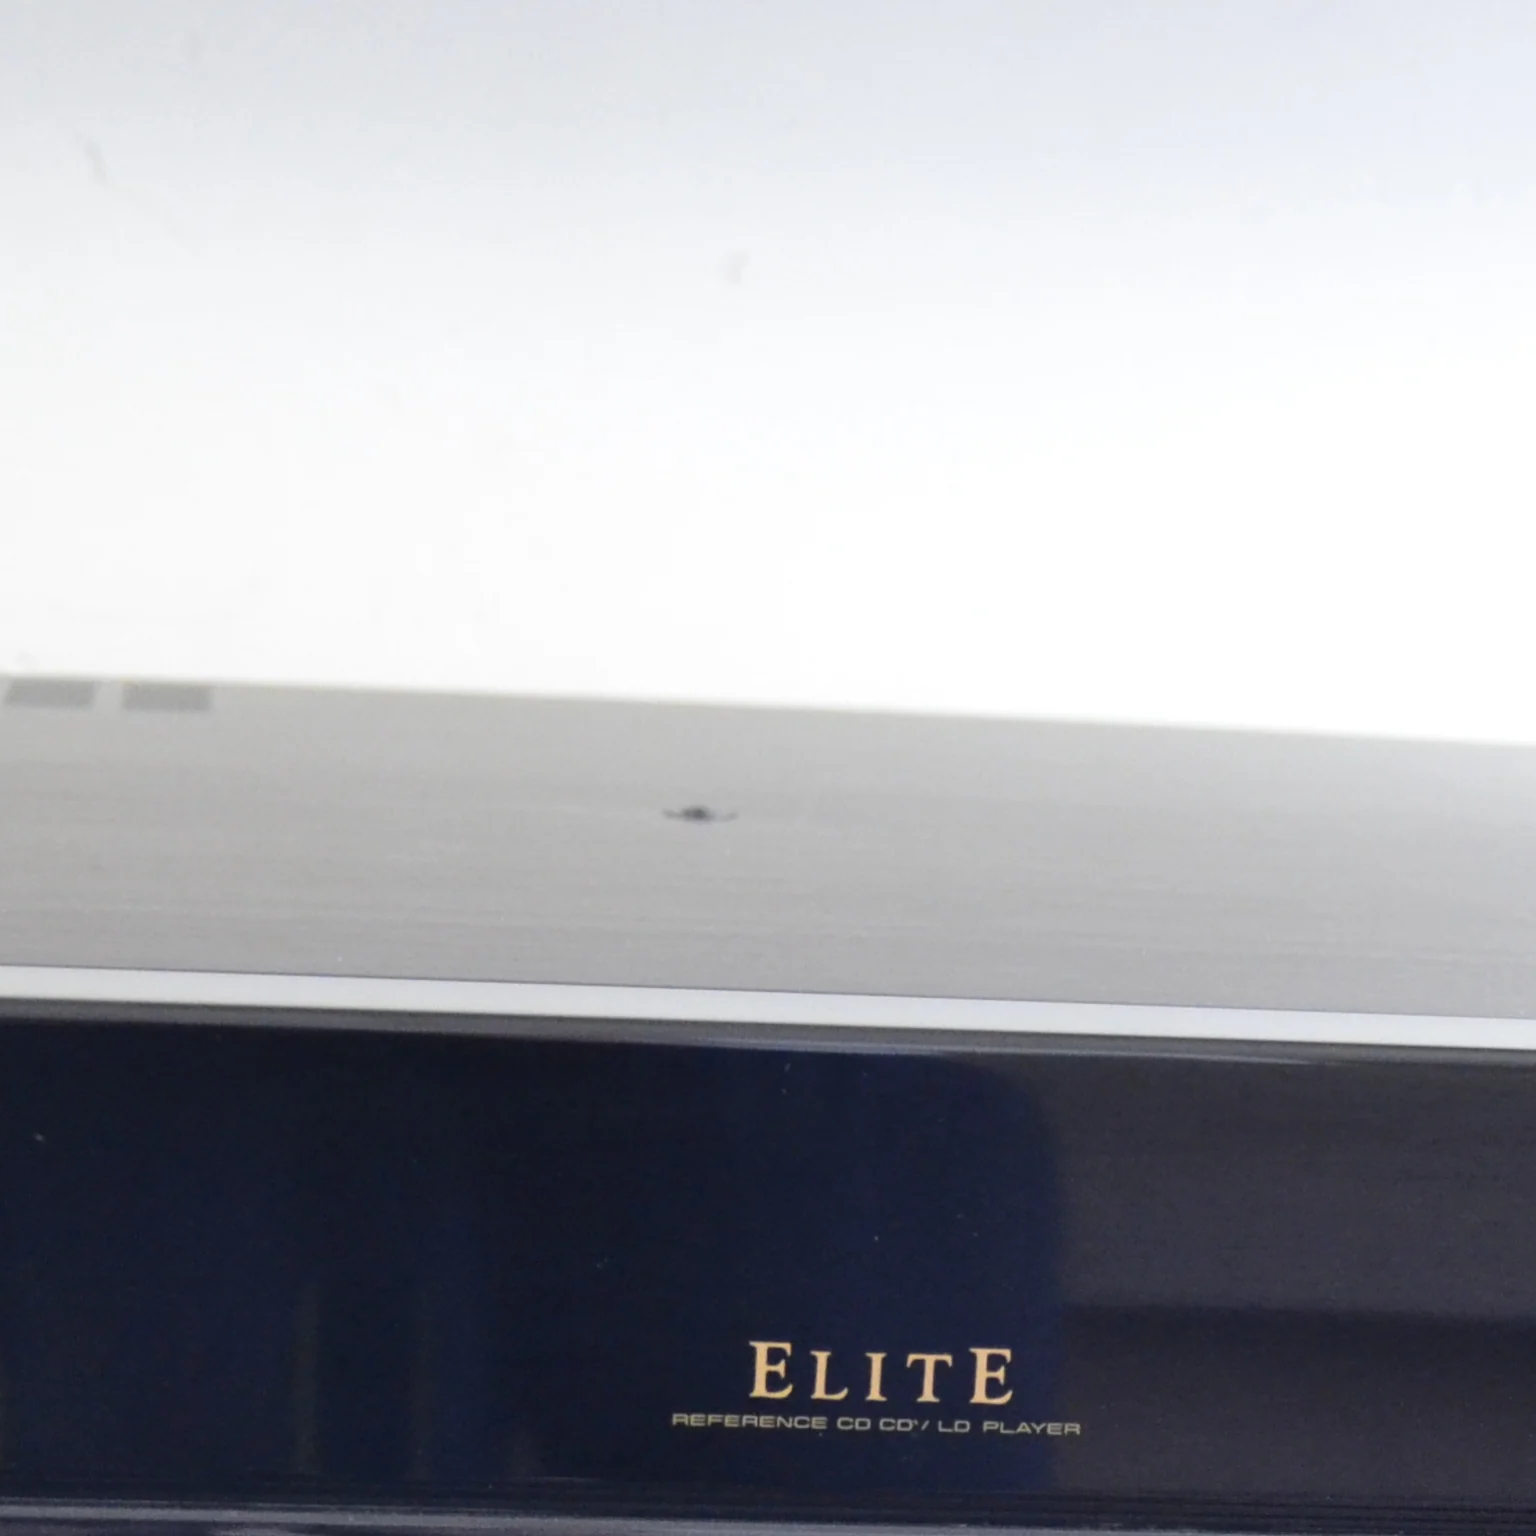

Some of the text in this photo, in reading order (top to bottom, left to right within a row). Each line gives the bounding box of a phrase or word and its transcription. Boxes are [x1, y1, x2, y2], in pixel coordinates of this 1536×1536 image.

[748, 1341, 1014, 1405] ELITE
[672, 1413, 828, 1430] REFERENCE
[836, 1416, 872, 1431] CD
[937, 1419, 971, 1433] LD
[983, 1420, 1081, 1436] PLAYER
